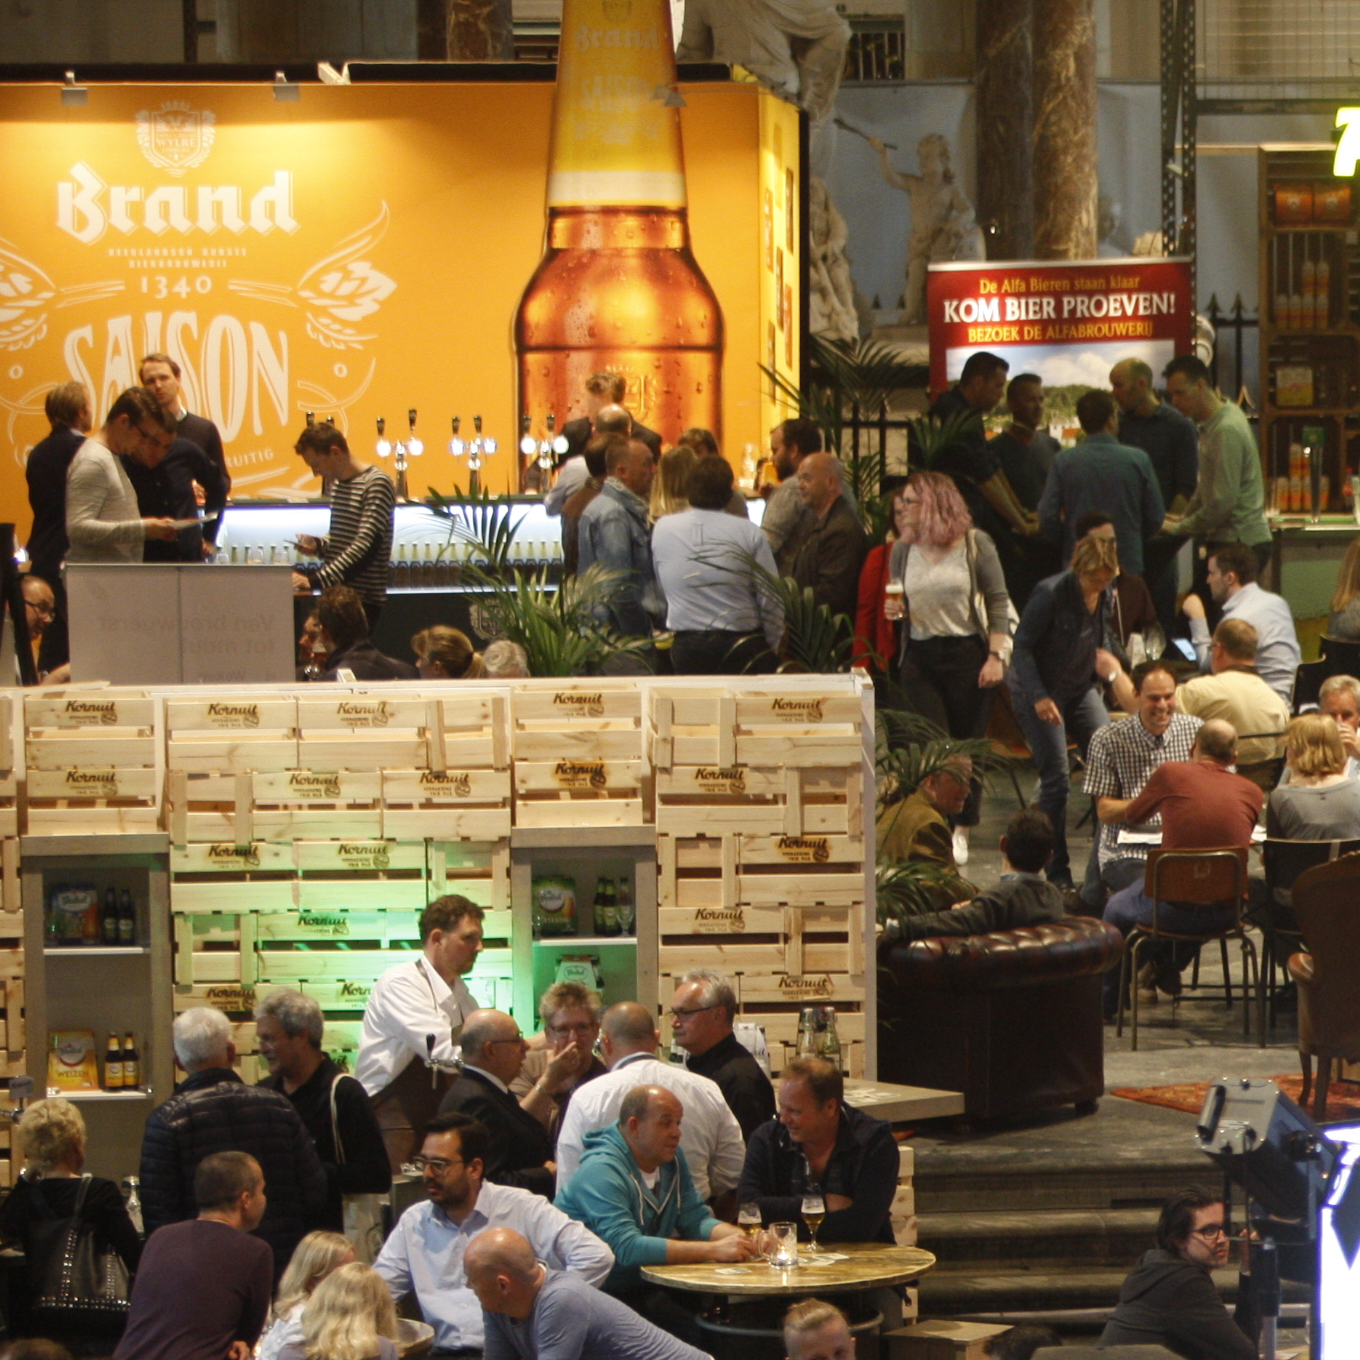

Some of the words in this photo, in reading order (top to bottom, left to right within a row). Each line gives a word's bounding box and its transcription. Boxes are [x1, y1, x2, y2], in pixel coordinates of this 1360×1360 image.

[56, 161, 301, 246] Brand
[141, 275, 213, 299] 1340
[979, 279, 998, 294] De
[1001, 278, 1026, 294] Alfa
[1030, 278, 1070, 292] Bieren
[1074, 277, 1106, 291] staan
[1110, 275, 1140, 289] klaar
[943, 297, 1000, 323] KOM
[1005, 296, 1057, 321] BIER
[1062, 294, 1176, 319] PROEVEN!
[968, 326, 1020, 343] BEZOEK
[1024, 325, 1042, 340] DE
[1046, 322, 1153, 339] ALFABROUWERIJ
[226, 448, 274, 467] RUITIG
[553, 692, 603, 704] Kornuit
[771, 698, 821, 710] Kornuit
[65, 700, 115, 713] Kornuit
[208, 703, 258, 716] Kornuit
[337, 701, 387, 714] Kornuit
[555, 762, 604, 775] Kornuit
[695, 768, 744, 780] Kornuit
[66, 770, 115, 783] Kornuit
[289, 773, 340, 786] Kornuit
[419, 772, 469, 784] Kornuit
[338, 844, 389, 855] Kornuit
[778, 837, 828, 849] Kornuit
[208, 845, 258, 857] Kornuit
[695, 908, 744, 921] Kornuit
[341, 982, 372, 996] Korn
[778, 976, 828, 989] Kornuit
